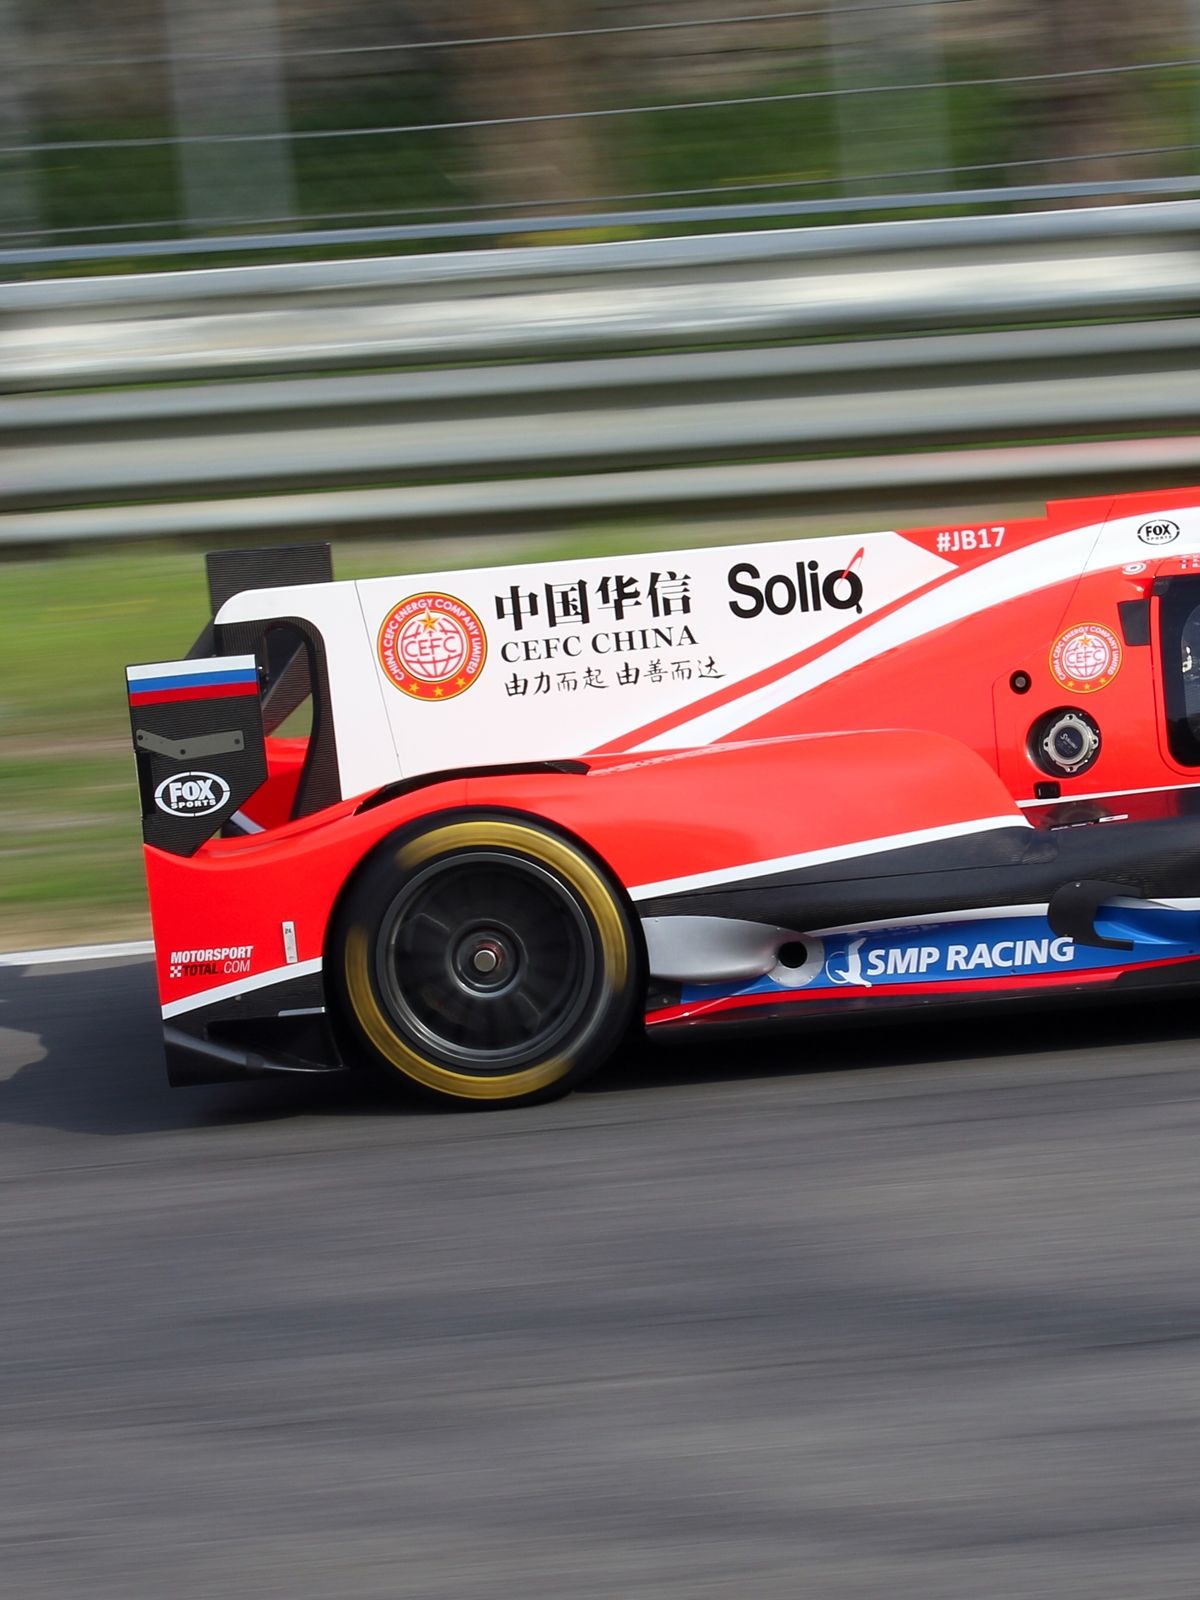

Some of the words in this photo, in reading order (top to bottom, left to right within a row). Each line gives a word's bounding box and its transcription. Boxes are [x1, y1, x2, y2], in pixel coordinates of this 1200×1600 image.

[936, 526, 1005, 553] #JB17
[1145, 524, 1171, 538] FOX
[394, 599, 433, 622] ENERGY
[494, 571, 692, 631] 中国华信
[435, 599, 480, 638] COMPANY
[405, 636, 457, 658] CEFC
[466, 637, 482, 674] LIMITED
[501, 635, 582, 663] CEFC
[591, 625, 700, 654] CHINA
[384, 649, 405, 680] CHINA
[1067, 649, 1102, 664] CEFC
[169, 779, 216, 803] FOX
[170, 799, 217, 809] SPORTS
[170, 945, 254, 964] MOTORSPORT
[867, 947, 940, 976] SMP
[946, 936, 1074, 971] RACING
[183, 963, 219, 976] TOTAL
